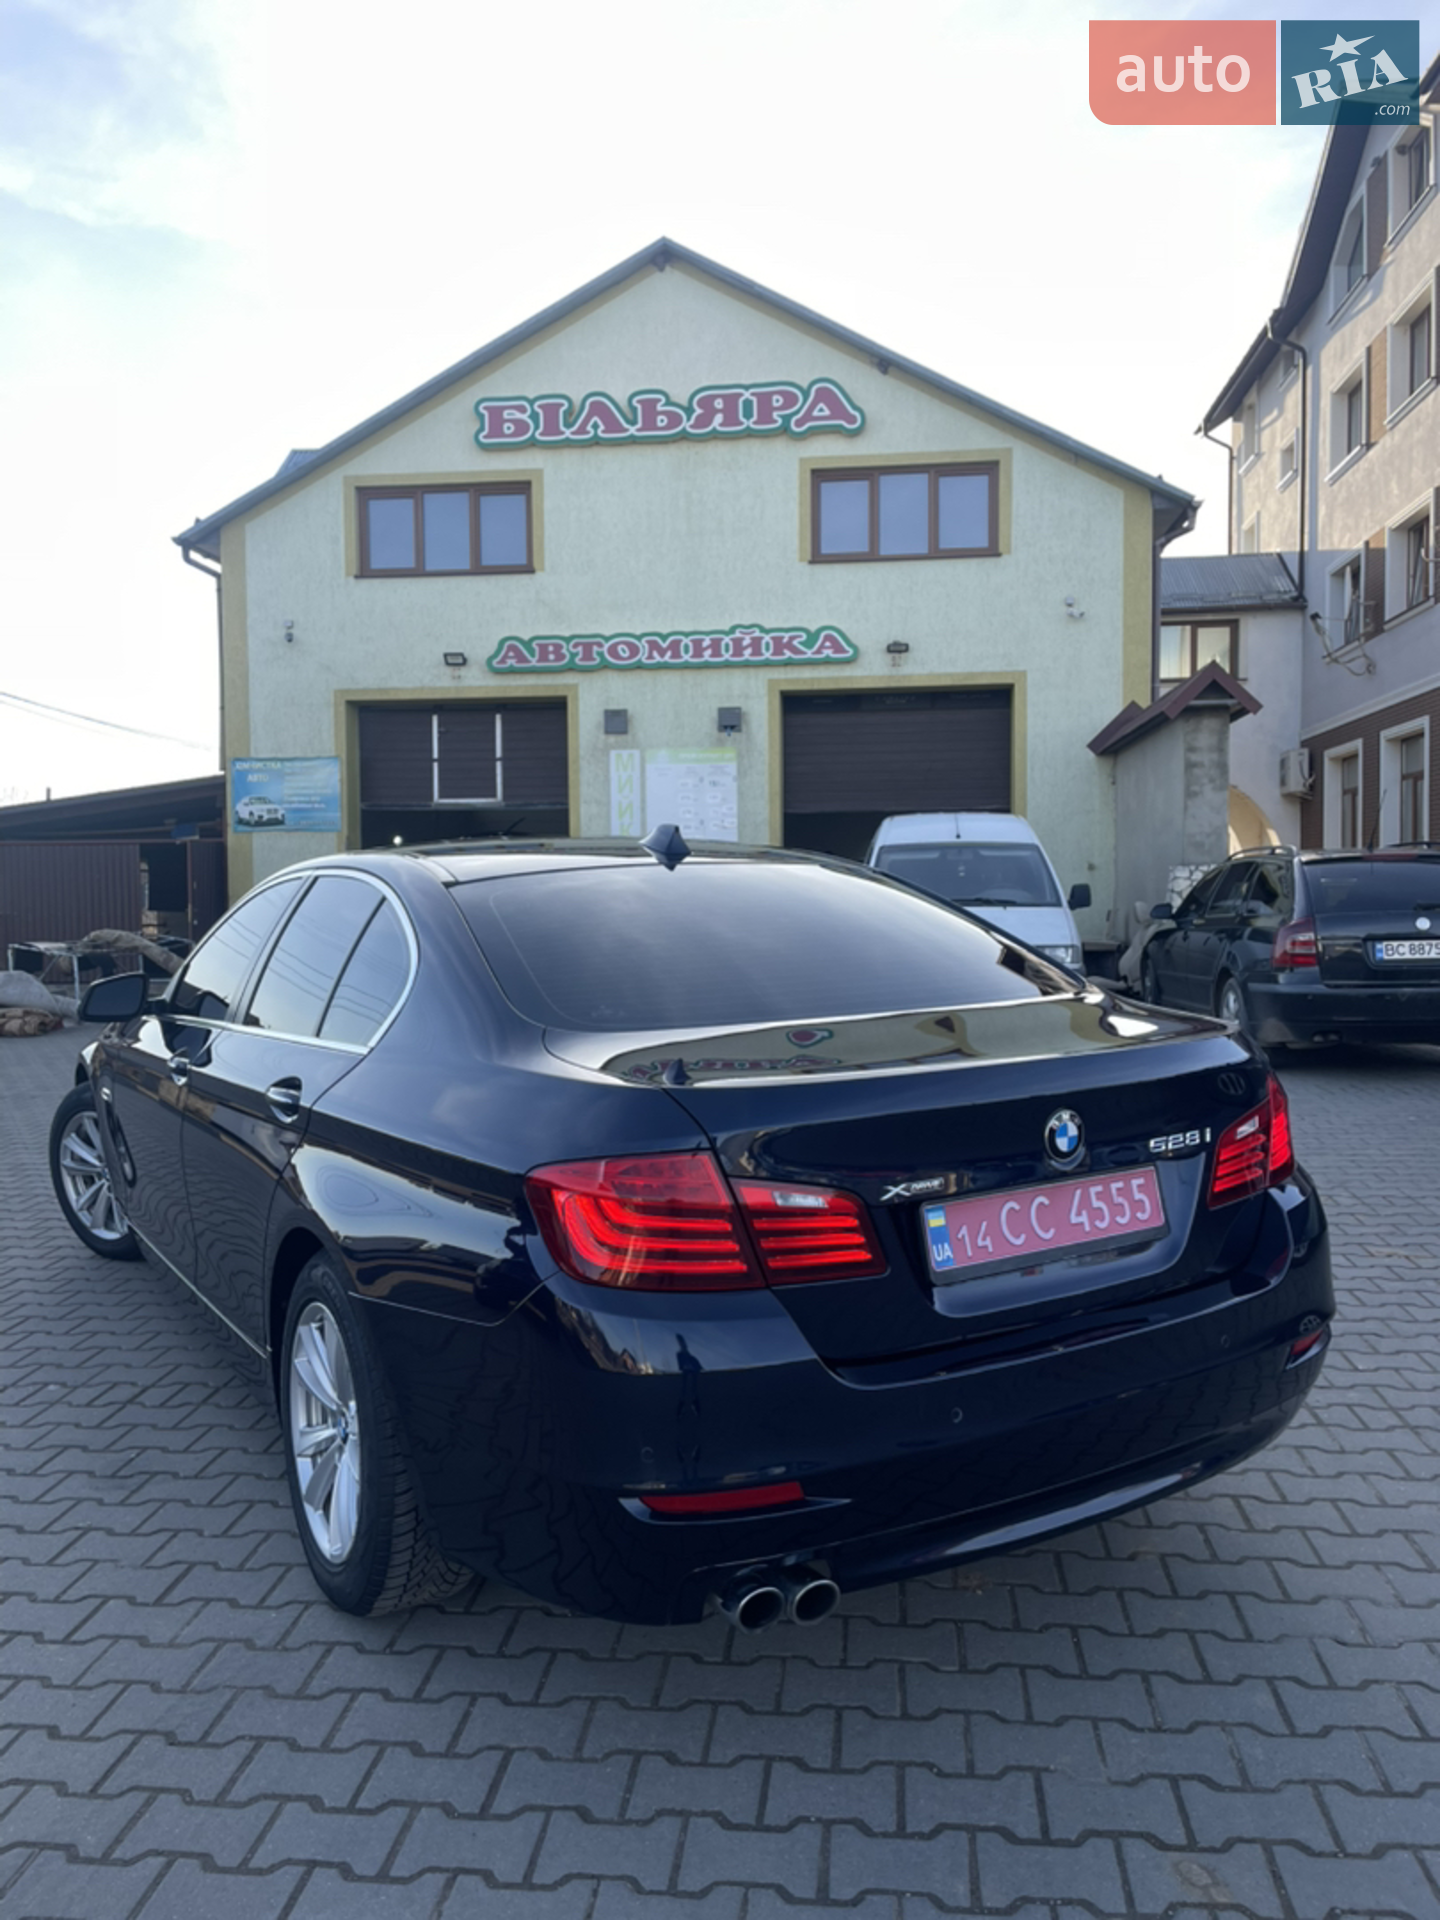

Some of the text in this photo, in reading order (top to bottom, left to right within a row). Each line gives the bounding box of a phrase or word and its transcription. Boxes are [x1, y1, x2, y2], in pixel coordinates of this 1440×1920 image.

[479, 383, 862, 442] БІЛЬЯРД
[492, 629, 853, 668] АВТОМИЙКА
[1384, 943, 1406, 957] BC
[957, 1177, 1152, 1257] 14 CC 4555
[933, 1242, 953, 1262] UA
